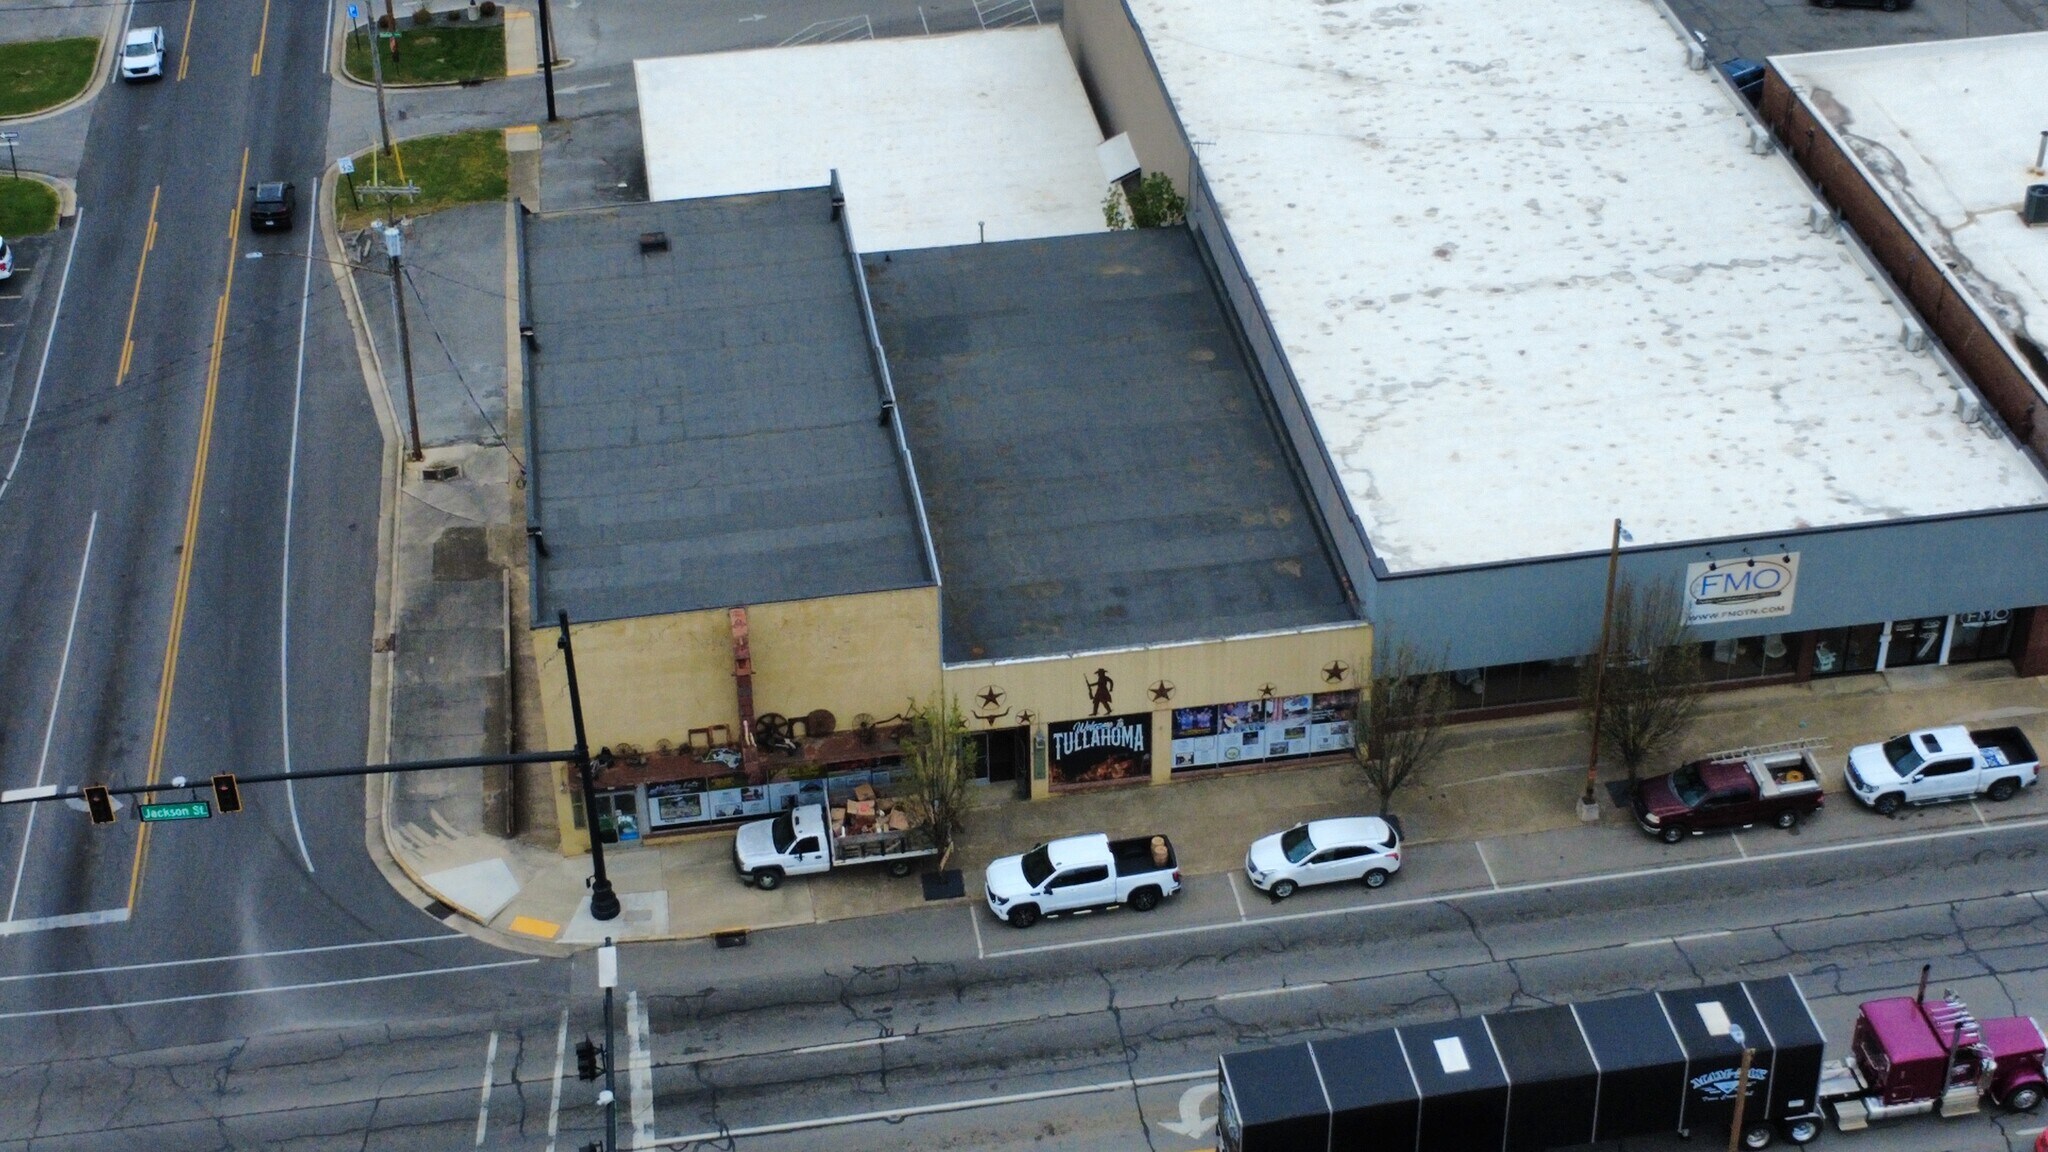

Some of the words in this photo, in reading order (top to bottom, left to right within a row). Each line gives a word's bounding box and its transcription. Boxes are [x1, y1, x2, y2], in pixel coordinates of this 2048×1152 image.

[1701, 568, 1780, 596] FMO
[1053, 723, 1145, 760] TULLAHOMA
[144, 807, 189, 819] Jackson
